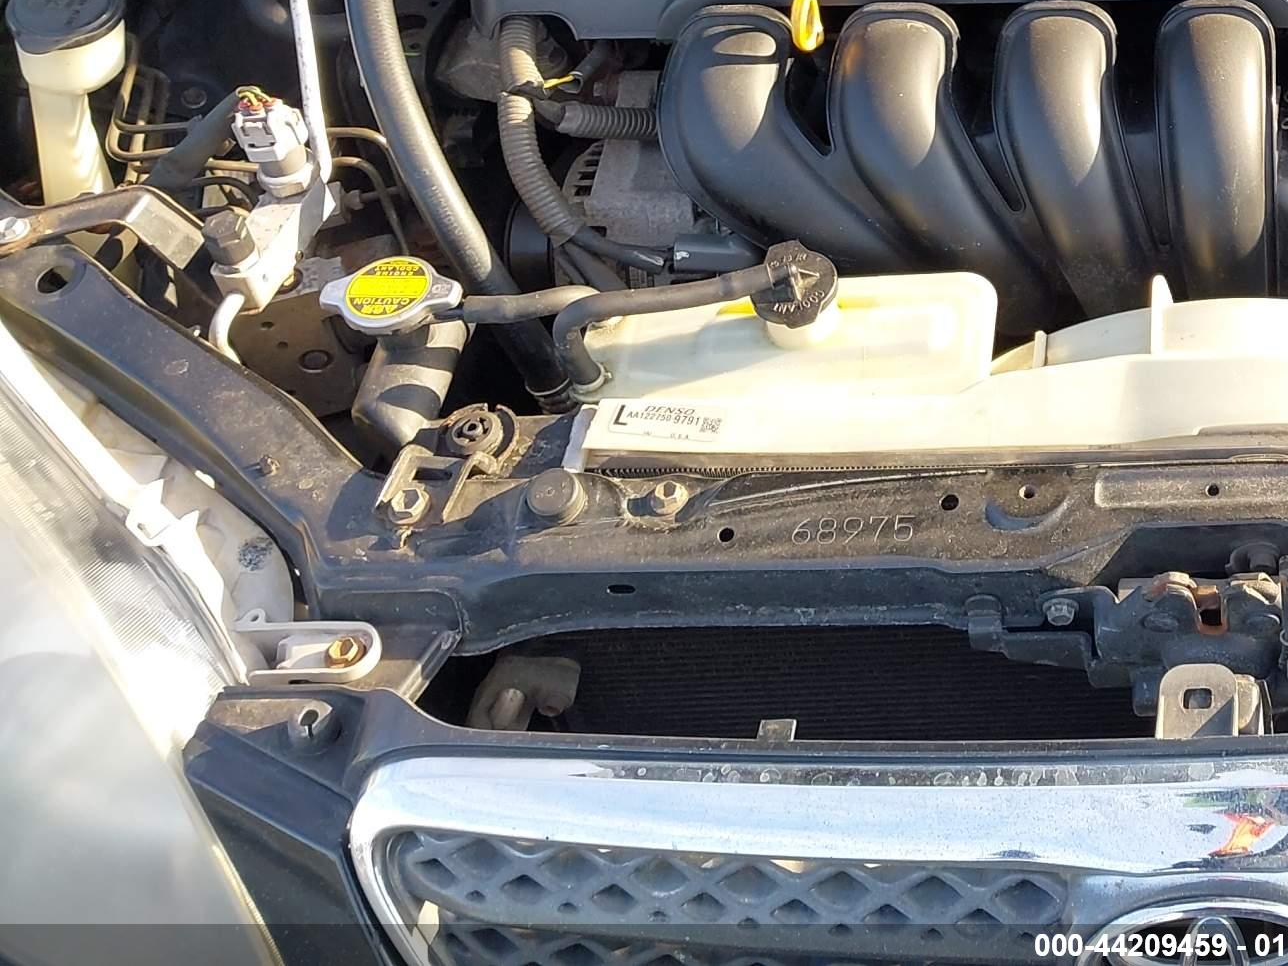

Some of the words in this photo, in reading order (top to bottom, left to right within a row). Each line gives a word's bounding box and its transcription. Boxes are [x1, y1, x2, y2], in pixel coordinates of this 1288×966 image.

[353, 297, 410, 305] CAUTION
[612, 404, 628, 426] L
[644, 405, 696, 415] DENSO
[791, 515, 917, 546] 68975
